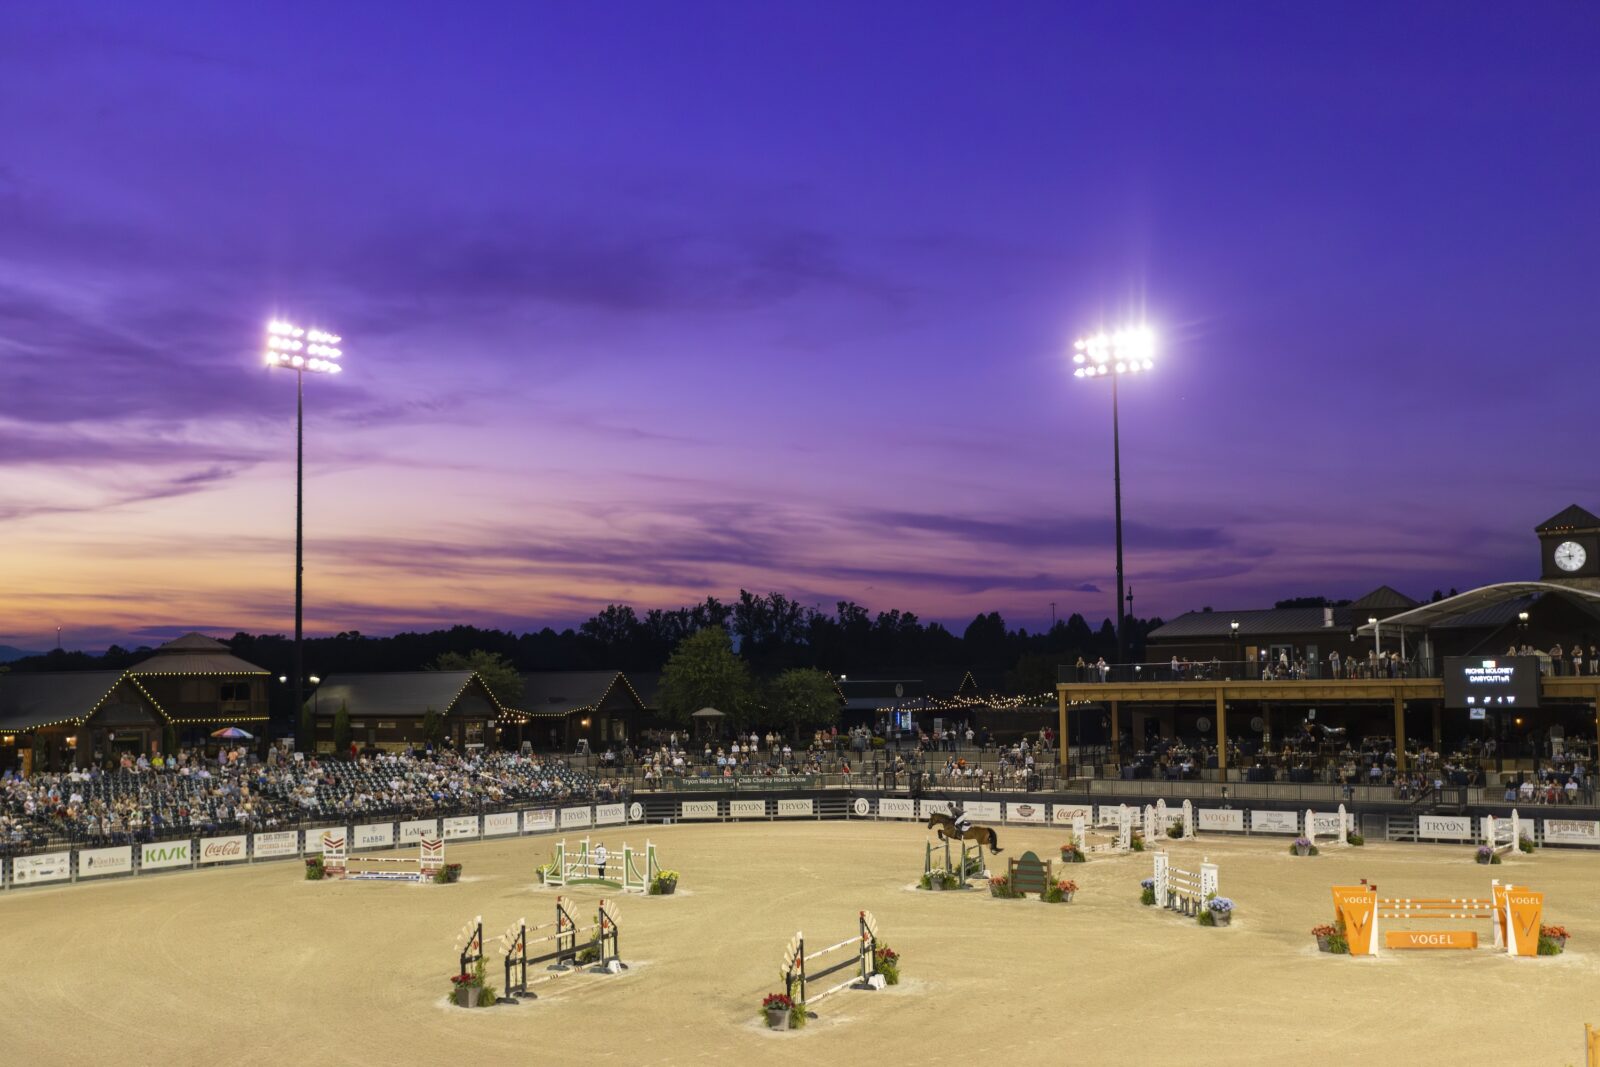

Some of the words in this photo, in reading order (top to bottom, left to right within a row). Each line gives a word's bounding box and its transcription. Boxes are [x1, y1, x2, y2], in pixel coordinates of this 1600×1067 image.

[684, 804, 714, 812] TRYON
[732, 802, 762, 811] TRYON
[780, 802, 810, 810] TRYON
[882, 802, 911, 811] TRYON
[564, 810, 588, 820] TRYON
[599, 808, 622, 817] TRYON
[488, 817, 512, 826] VOGEL
[1204, 813, 1236, 822] VOGEL
[1424, 821, 1464, 831] TRYON
[145, 846, 187, 862] KASK
[1510, 896, 1540, 904] VOGEL
[1410, 934, 1454, 944] VOGEL
